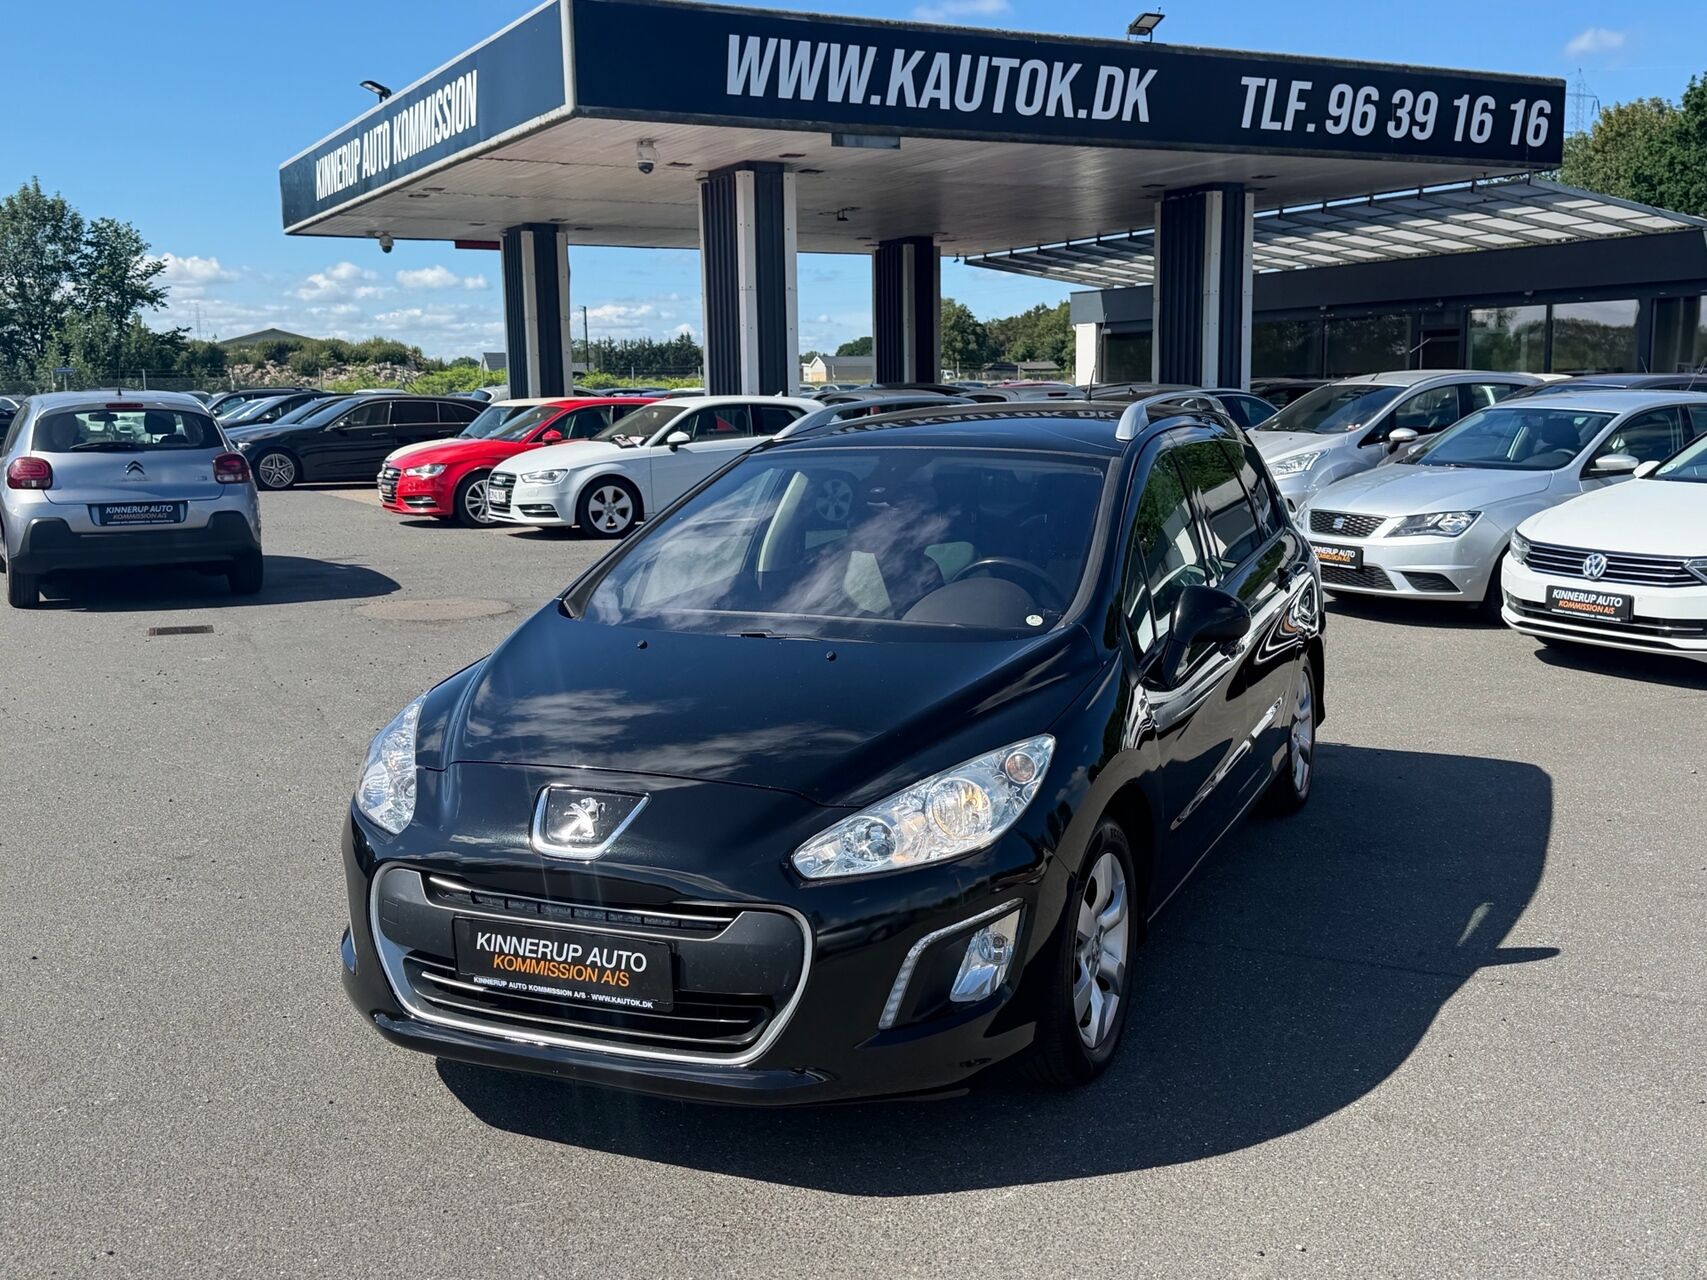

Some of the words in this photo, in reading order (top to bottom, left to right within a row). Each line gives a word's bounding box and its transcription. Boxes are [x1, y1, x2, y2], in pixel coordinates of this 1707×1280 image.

[726, 34, 1158, 123] WWW.KAUTOK.DK
[1241, 76, 1316, 133] TLF.
[1325, 83, 1379, 136] 96
[1387, 88, 1439, 140] 39
[1452, 93, 1496, 144] 16
[1509, 98, 1552, 148] 16
[315, 137, 361, 201] KINNERUP
[362, 120, 390, 179] AUTO
[393, 69, 478, 164] KOMMISSION
[106, 506, 149, 514] KINNERUP
[150, 504, 174, 513] AUTO
[1338, 549, 1356, 558] AUTO
[1552, 589, 1597, 604] KINNERUP
[1596, 595, 1623, 607] AUTO
[1558, 600, 1604, 613] KOMMISSION
[476, 932, 583, 963] KINNERUP
[586, 947, 648, 973] AUTO
[493, 954, 598, 983] KOMMISSION
[601, 970, 630, 988] A/S
[473, 976, 508, 987] KINNERUP
[509, 981, 527, 991] AUTO
[528, 984, 573, 997] KOMMISSION
[574, 990, 587, 999] A/S
[591, 993, 654, 1009] WWW.KAUTOK.DK
